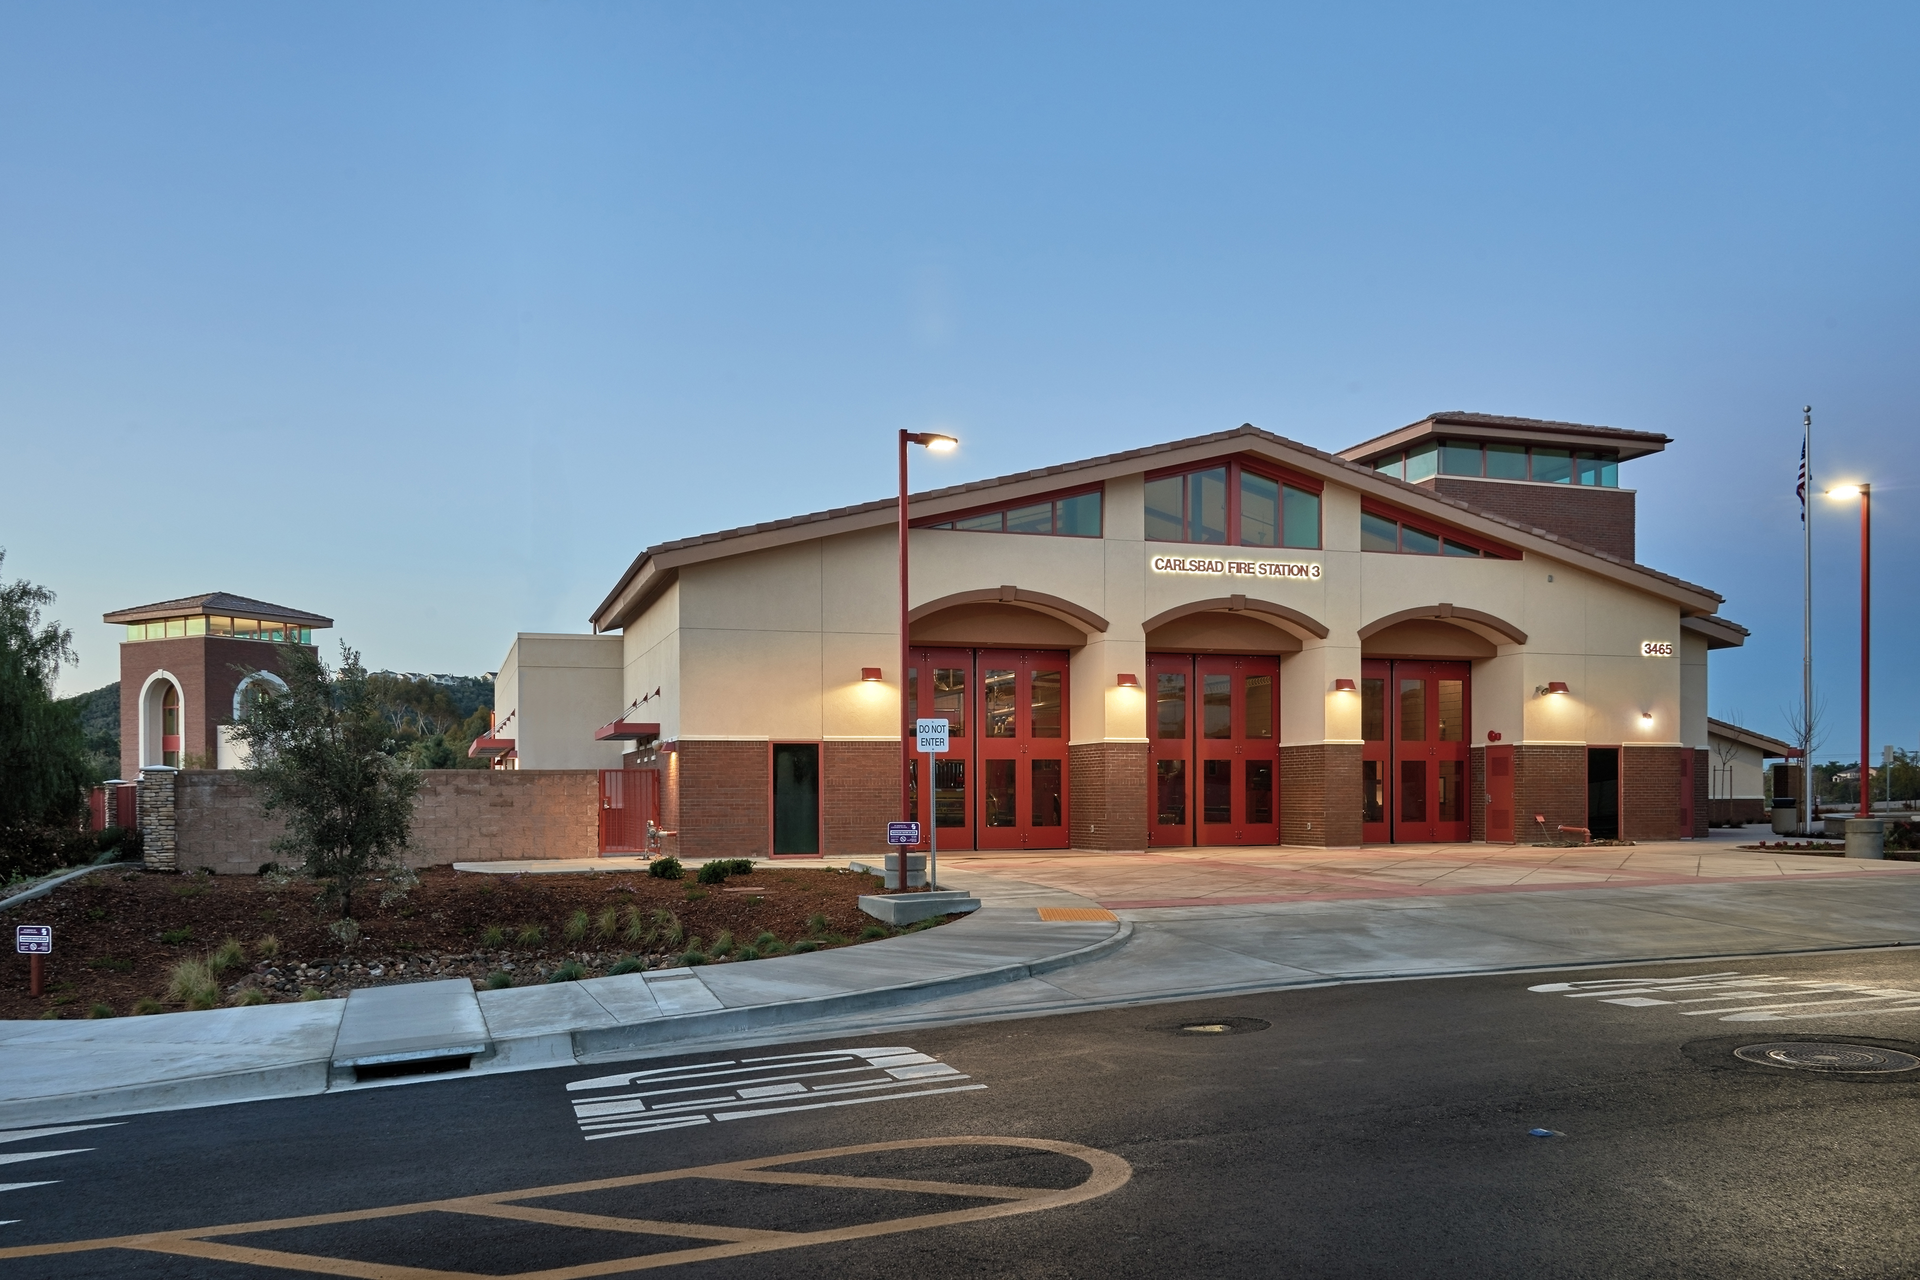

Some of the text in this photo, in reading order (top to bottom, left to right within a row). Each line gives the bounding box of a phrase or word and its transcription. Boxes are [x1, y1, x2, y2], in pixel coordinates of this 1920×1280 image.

[1154, 557, 1321, 578] CARLSBAD FIRE STATION 3
[1644, 643, 1673, 655] 3465
[919, 724, 946, 734] DO NOT
[920, 738, 945, 747] ENTER
[565, 1046, 988, 1141] YIELD
